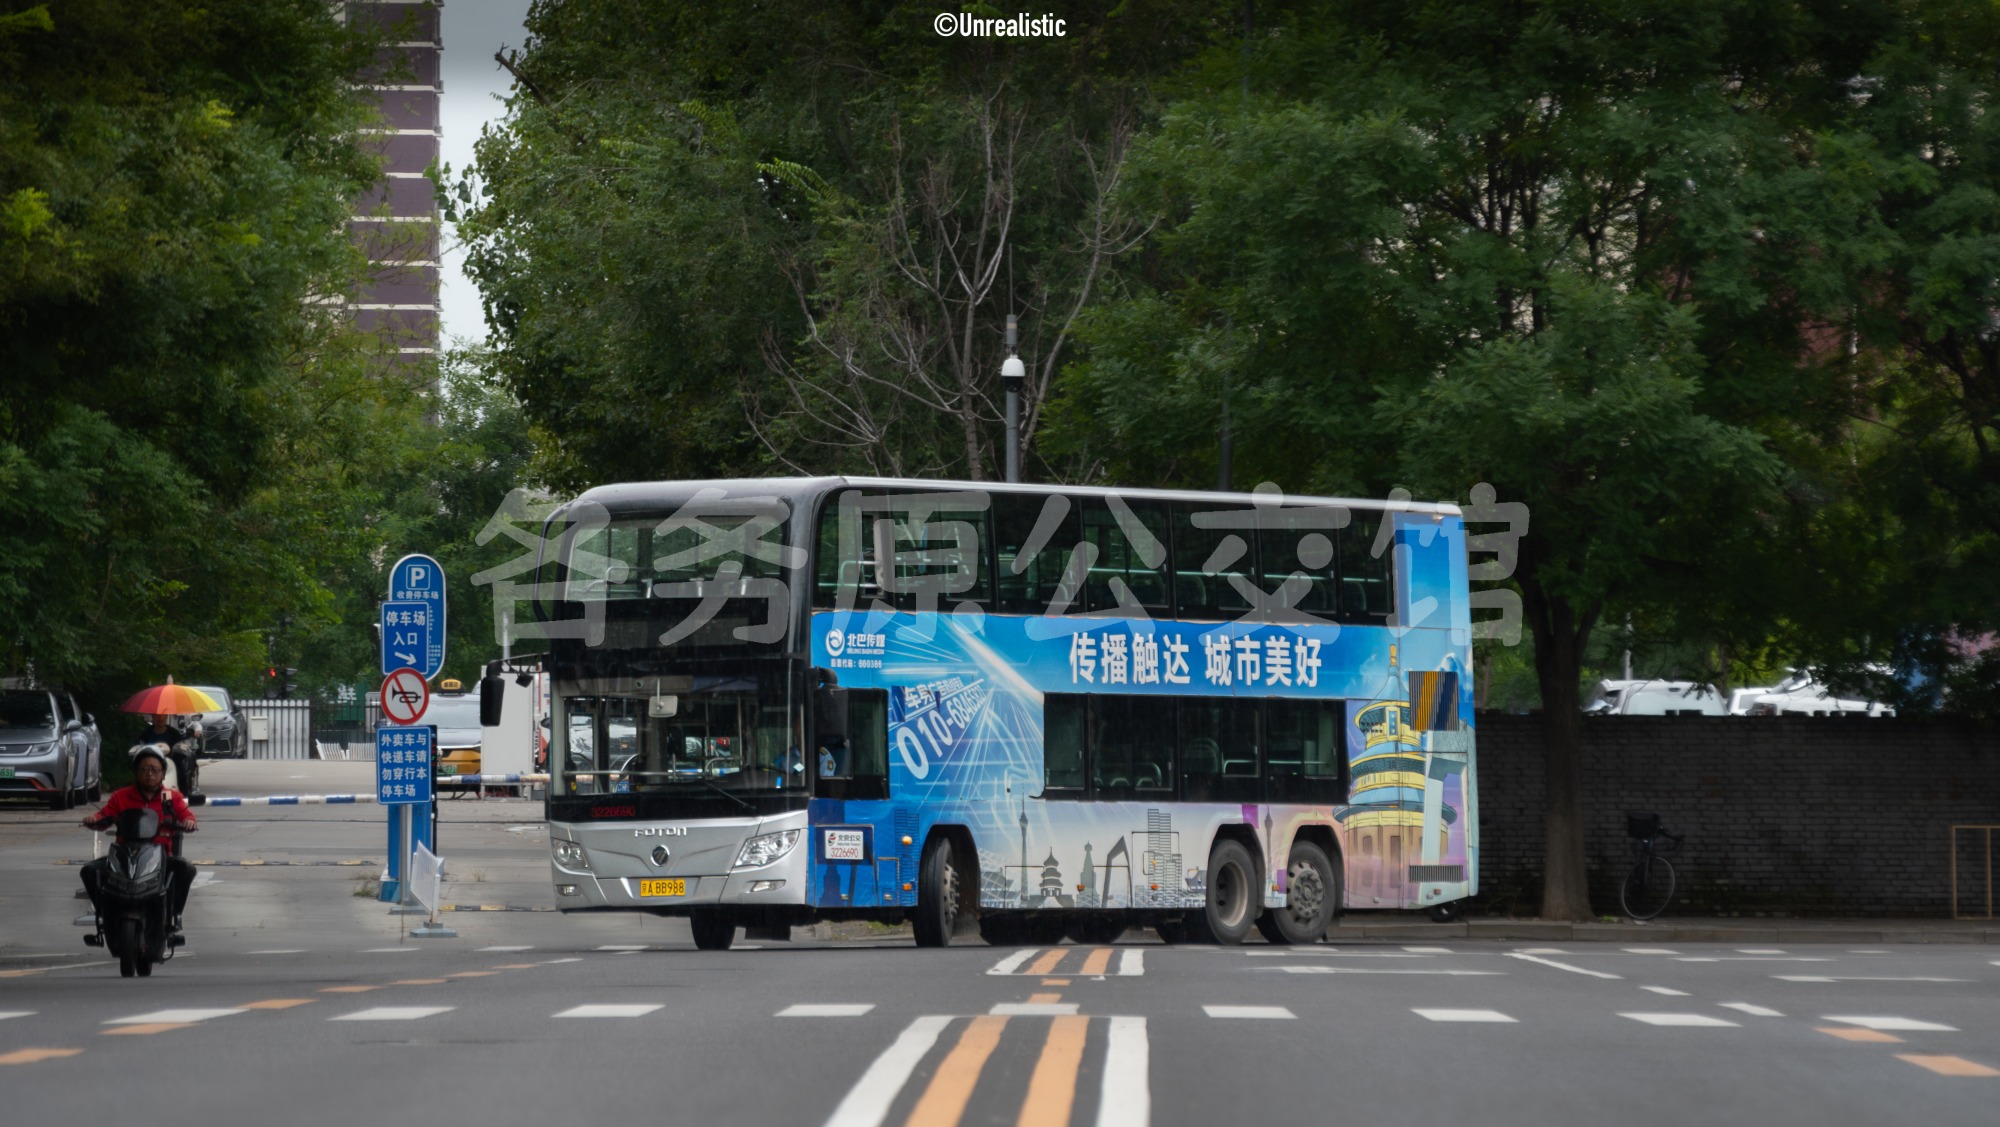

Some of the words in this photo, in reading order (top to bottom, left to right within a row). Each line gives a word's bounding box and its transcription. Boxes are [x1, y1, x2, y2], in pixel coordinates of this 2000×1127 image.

[410, 567, 426, 588] P
[396, 590, 439, 600] 收费停车场
[386, 610, 426, 627] 停车场
[393, 631, 418, 646] 入口
[847, 633, 886, 648] 北巴传媒
[1069, 631, 1191, 685] 传播触达
[1204, 635, 1322, 687] 城市美好
[381, 733, 427, 747] 外卖车与
[381, 750, 427, 764] 快递车请
[381, 767, 428, 780] 勿穿行本
[381, 784, 416, 798] 停车场
[591, 806, 635, 818] 3226690
[634, 827, 687, 837] FOTON
[831, 847, 859, 858] 3226690
